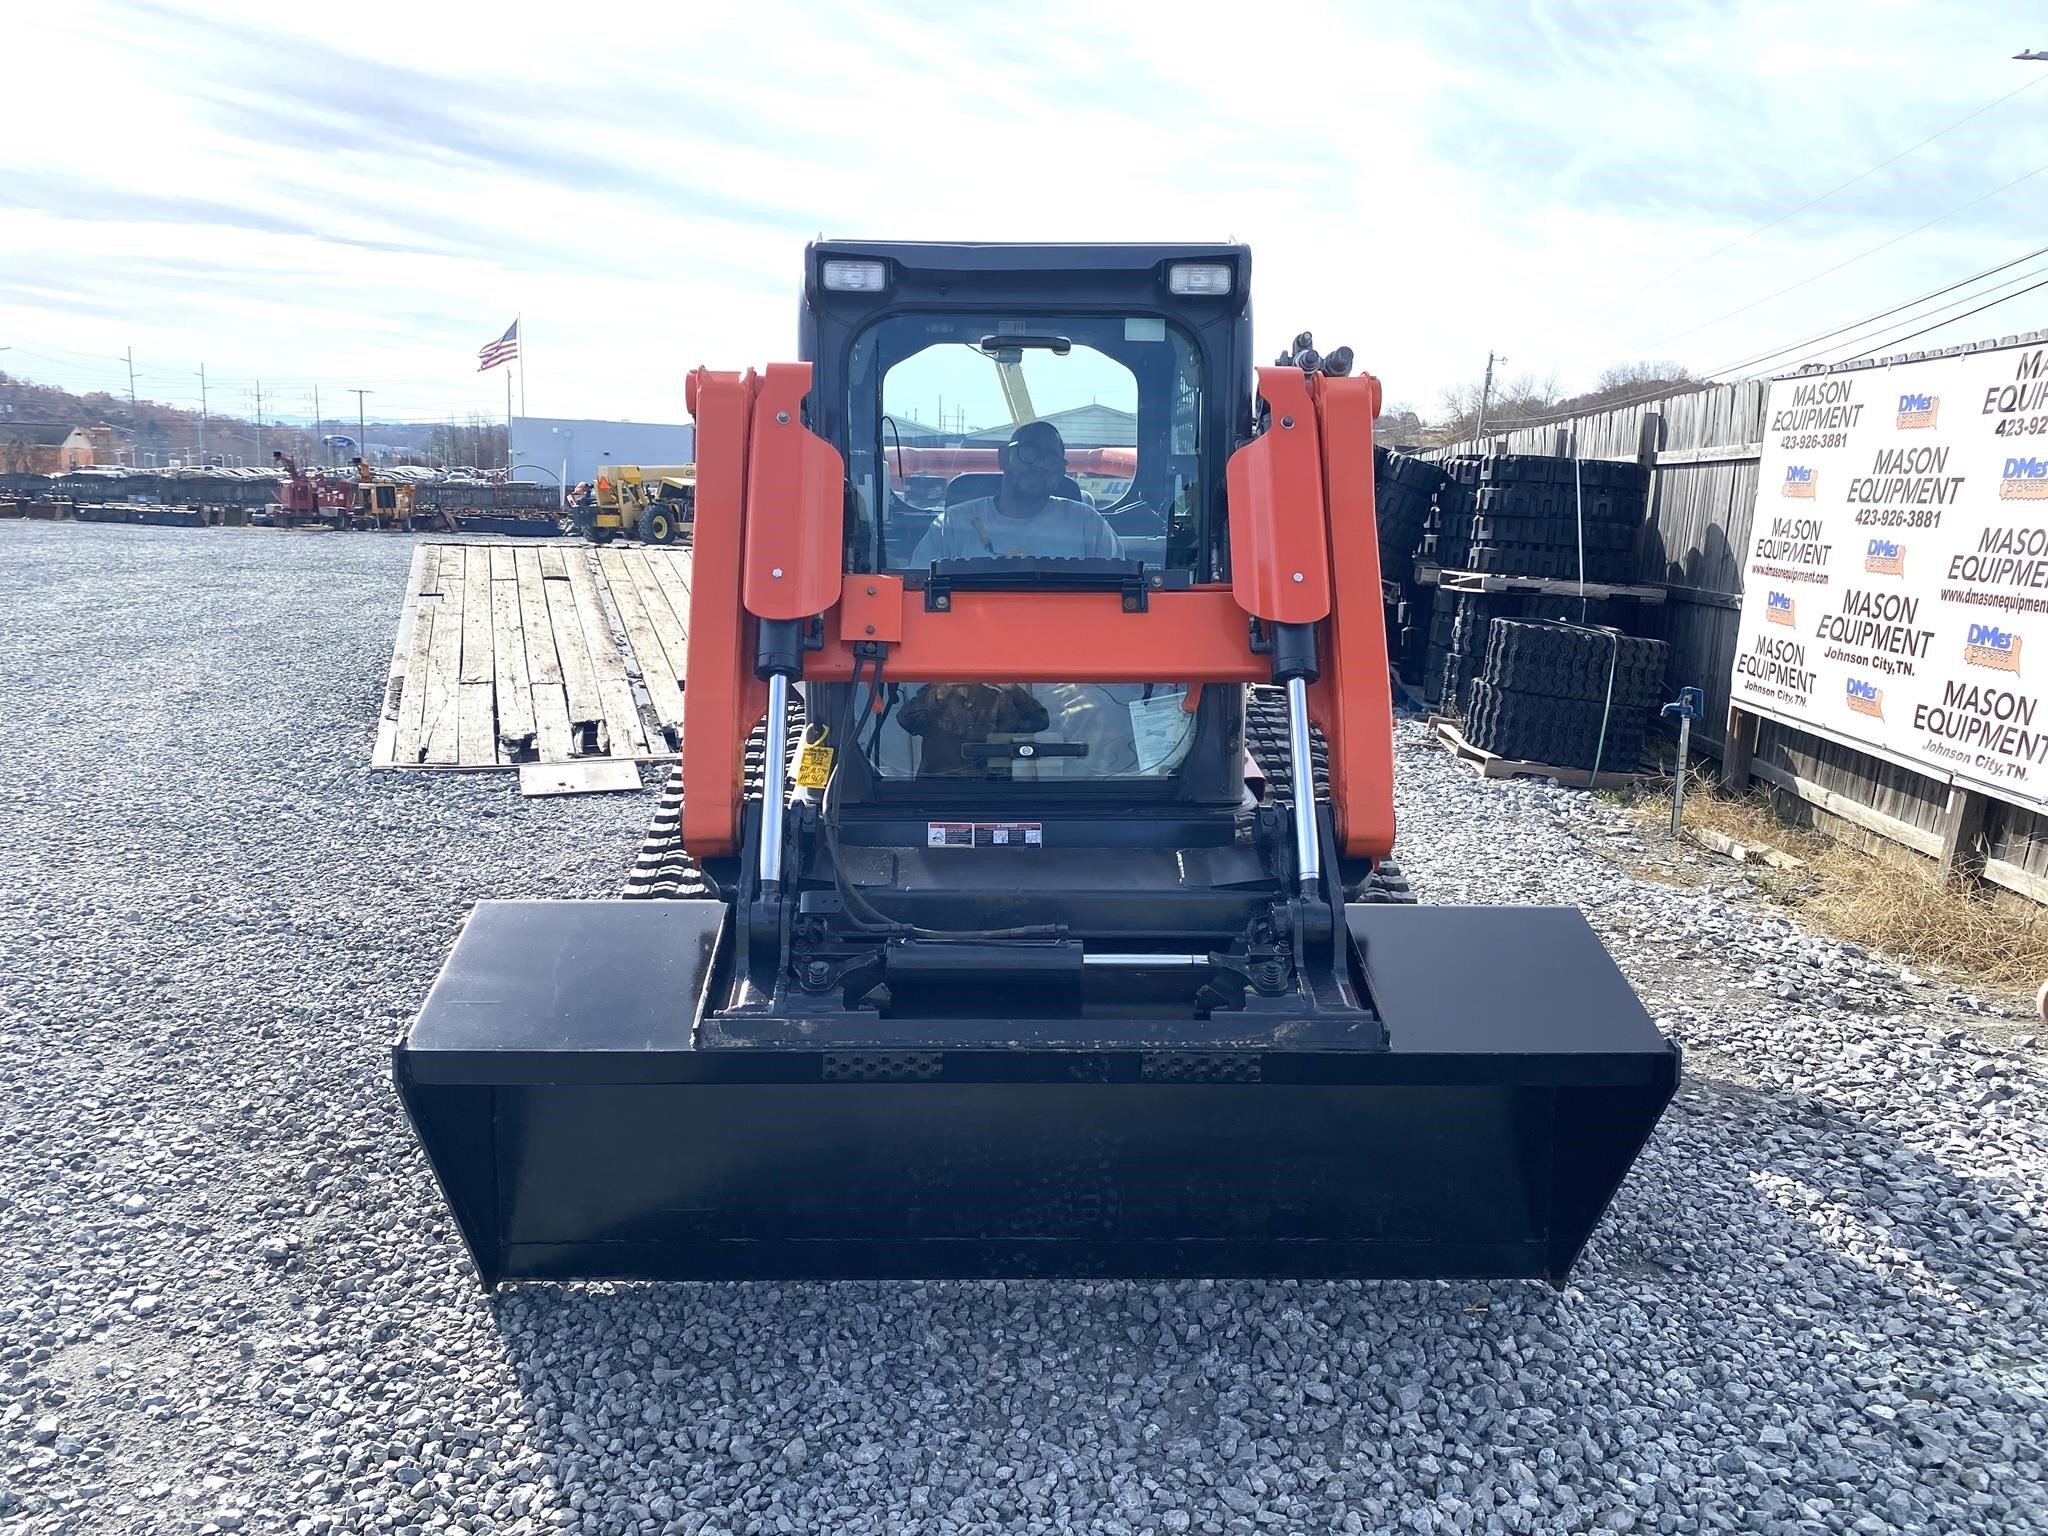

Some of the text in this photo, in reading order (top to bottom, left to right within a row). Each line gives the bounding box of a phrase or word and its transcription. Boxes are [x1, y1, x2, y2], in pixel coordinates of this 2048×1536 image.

[1792, 379, 1852, 407] MASON
[1771, 404, 1864, 432] EQUIPMENT
[1872, 446, 1950, 475] MASON
[1846, 477, 1965, 505] EQUIPMENT
[1772, 516, 1823, 541] MASON
[1855, 508, 1942, 528] 423-926-3881
[1756, 538, 1832, 566] EQUIPMENT
[1977, 527, 2048, 557] MASO
[1752, 563, 1829, 584] www.dmasonequipment.com
[1843, 589, 1919, 625] MASON
[1755, 634, 1805, 667] MASON
[1816, 614, 1935, 659] EQUIPMENT
[1824, 646, 1869, 666] Johnson
[1737, 653, 1817, 694] EQUIPMENT
[1744, 680, 1775, 697] Johnson
[1943, 679, 2038, 726] MASON
[1914, 703, 2048, 765] EQUIPMENT
[1922, 738, 1971, 764] Johnson
